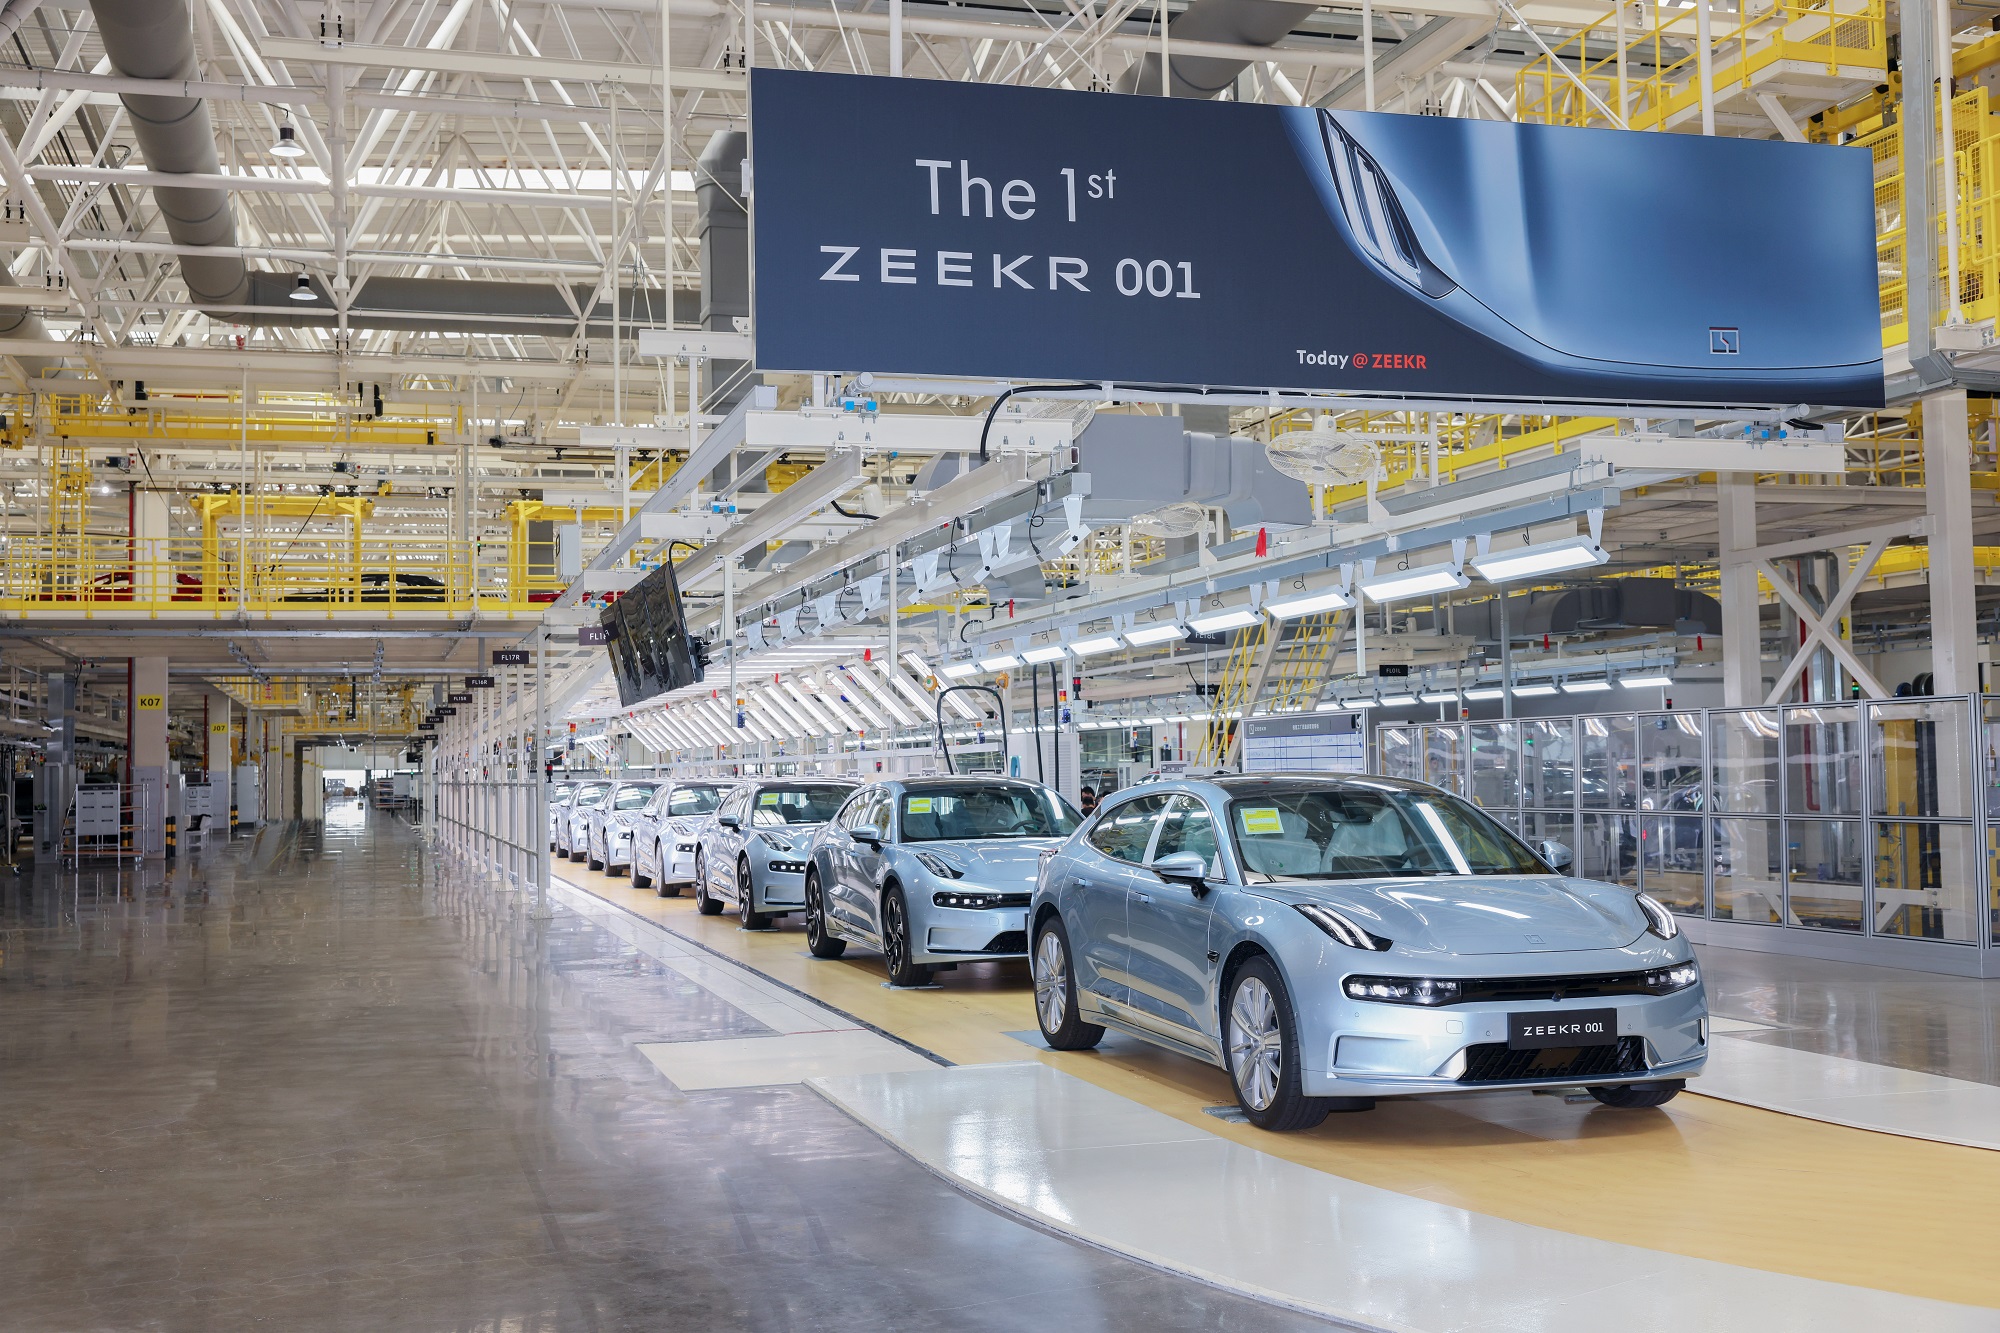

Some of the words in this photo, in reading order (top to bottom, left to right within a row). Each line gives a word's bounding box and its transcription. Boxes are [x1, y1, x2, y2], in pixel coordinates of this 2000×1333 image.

[915, 158, 1036, 221] The
[1060, 168, 1117, 222] 1st
[819, 245, 1091, 292] ZEEKR
[1115, 257, 1201, 299] 001
[1296, 349, 1349, 370] Today
[1352, 353, 1369, 369] @
[1371, 353, 1427, 369] ZEEKR
[140, 698, 161, 707] K07
[1523, 1024, 1581, 1036] ZEEKR
[1585, 1022, 1604, 1033] 001
